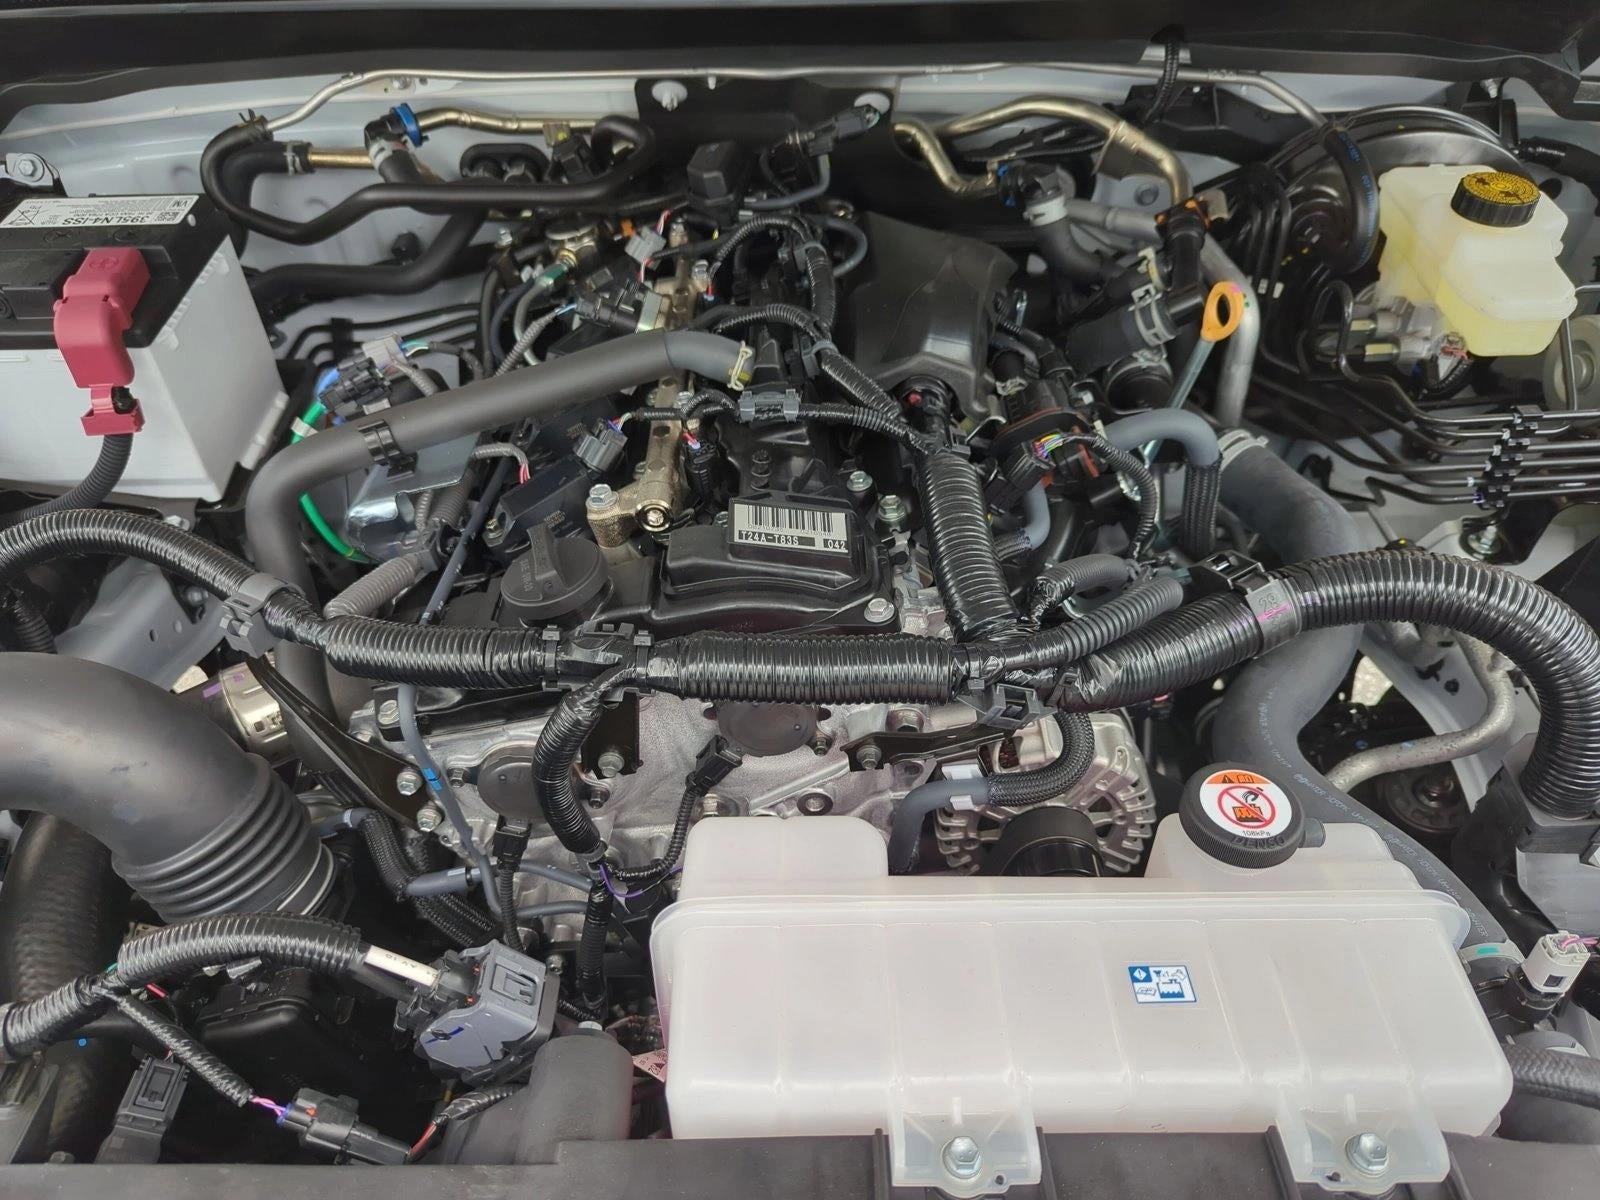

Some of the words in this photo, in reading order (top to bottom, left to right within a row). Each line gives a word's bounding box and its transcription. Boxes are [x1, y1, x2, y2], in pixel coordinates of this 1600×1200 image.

[741, 531, 799, 546] T24A-T83S
[827, 540, 846, 550] 042
[1241, 829, 1271, 837] 108kPa
[1230, 835, 1285, 849] DENSO
